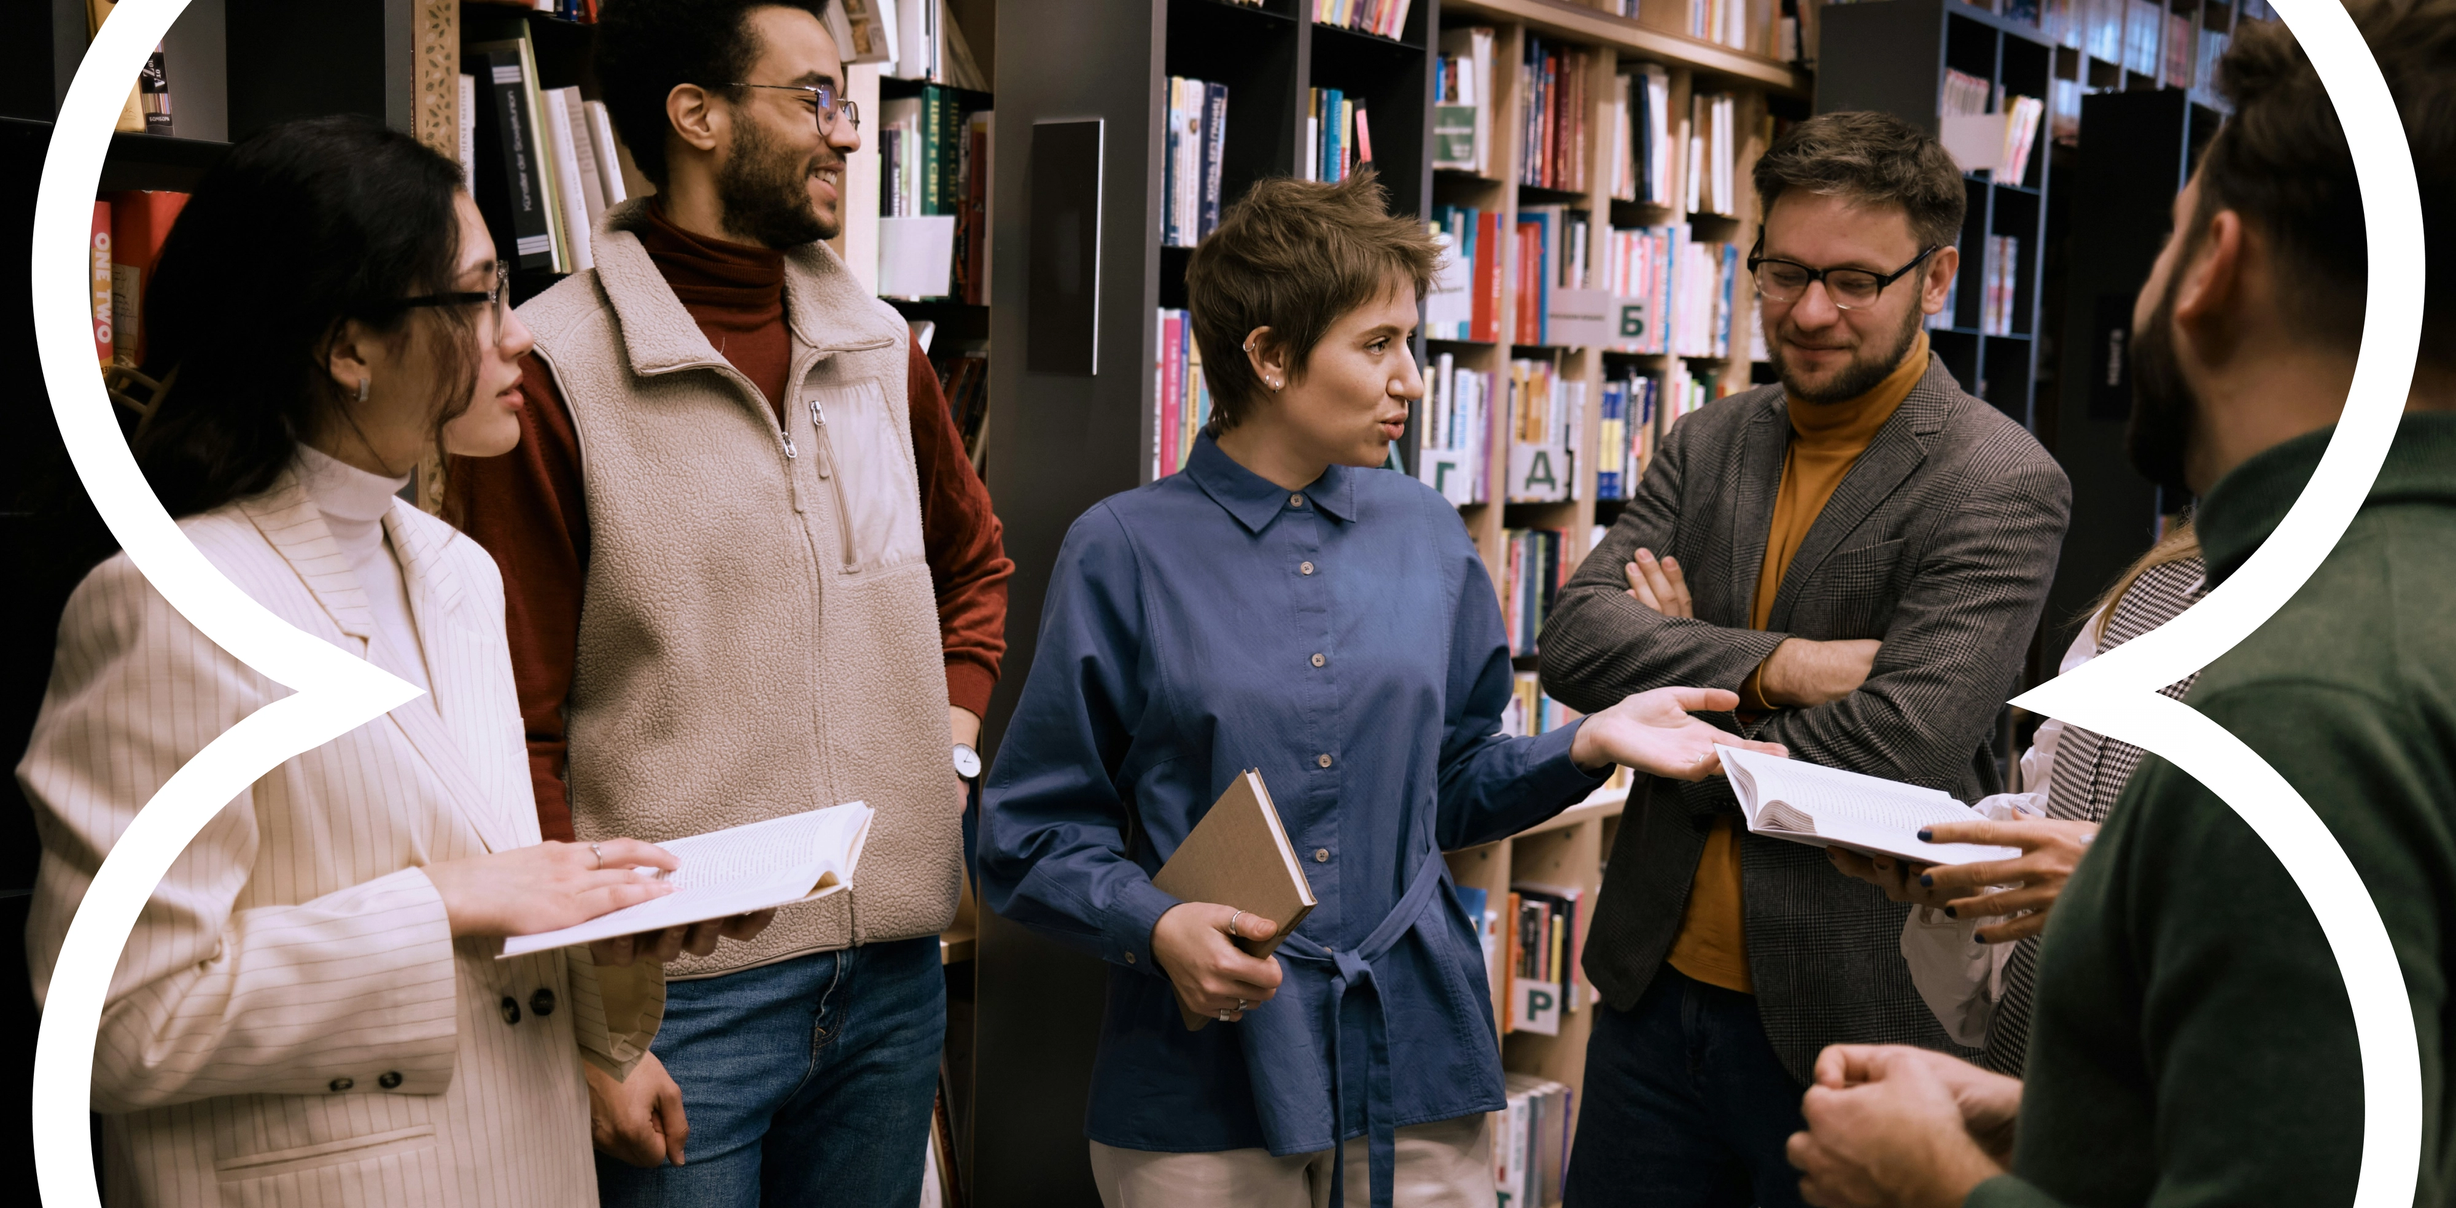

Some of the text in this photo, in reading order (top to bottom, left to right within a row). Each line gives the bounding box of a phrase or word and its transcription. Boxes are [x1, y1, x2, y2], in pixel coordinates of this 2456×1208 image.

[142, 67, 156, 78] Z
[930, 100, 939, 146] ЦВЕТ
[950, 102, 959, 146] ЦВЕТ
[507, 90, 532, 212] Künstler der Sowjetunion
[1207, 97, 1222, 202] ЖИЗНЬ БЕЗ ГРАНИЦ
[928, 162, 938, 206] СВЕТ
[948, 163, 959, 206] СВЕТ
[94, 232, 112, 344] ONE TWO
[1619, 305, 1644, 338] Б
[1435, 461, 1456, 495] Г
[1525, 451, 1556, 492] Д
[1527, 988, 1553, 1021] Р
